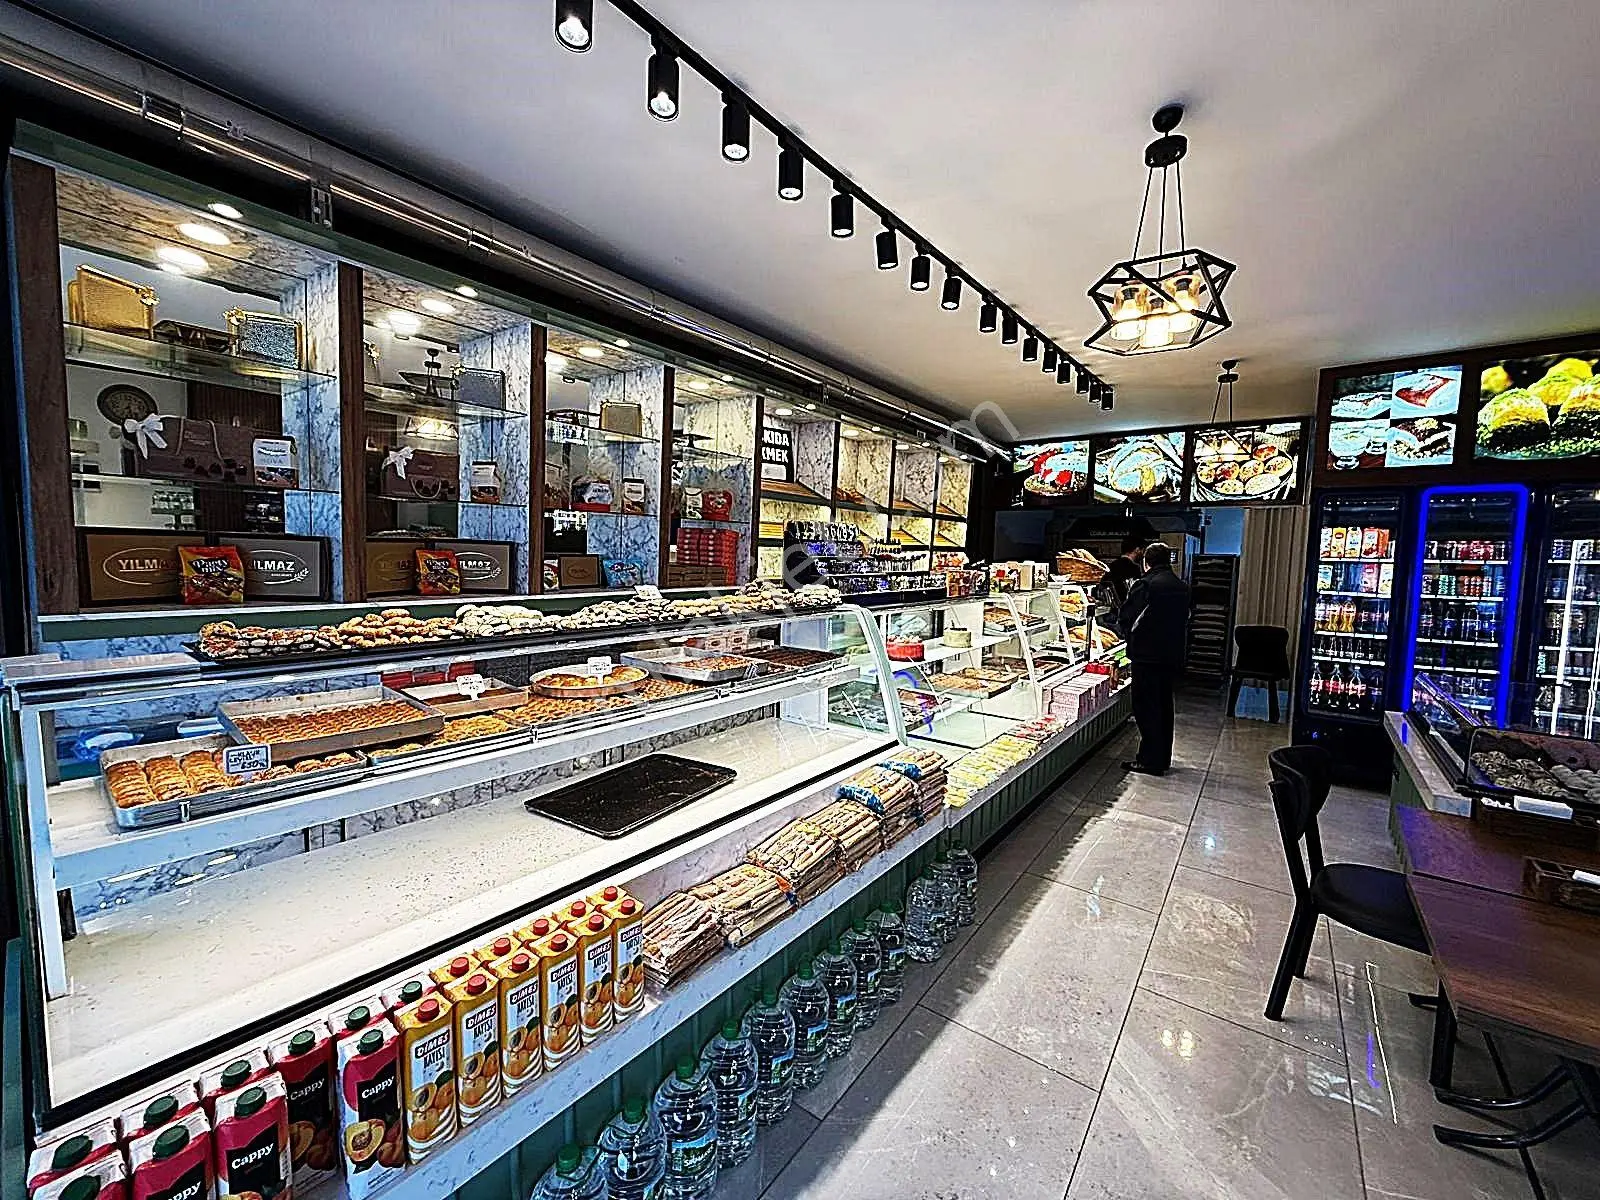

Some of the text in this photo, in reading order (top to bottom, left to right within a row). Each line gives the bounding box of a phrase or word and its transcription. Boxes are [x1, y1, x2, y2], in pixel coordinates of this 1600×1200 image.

[762, 429, 790, 447] KIDA
[290, 1078, 325, 1101] Cappy
[361, 1076, 395, 1099] Cappy
[231, 1143, 275, 1170] Cappy
